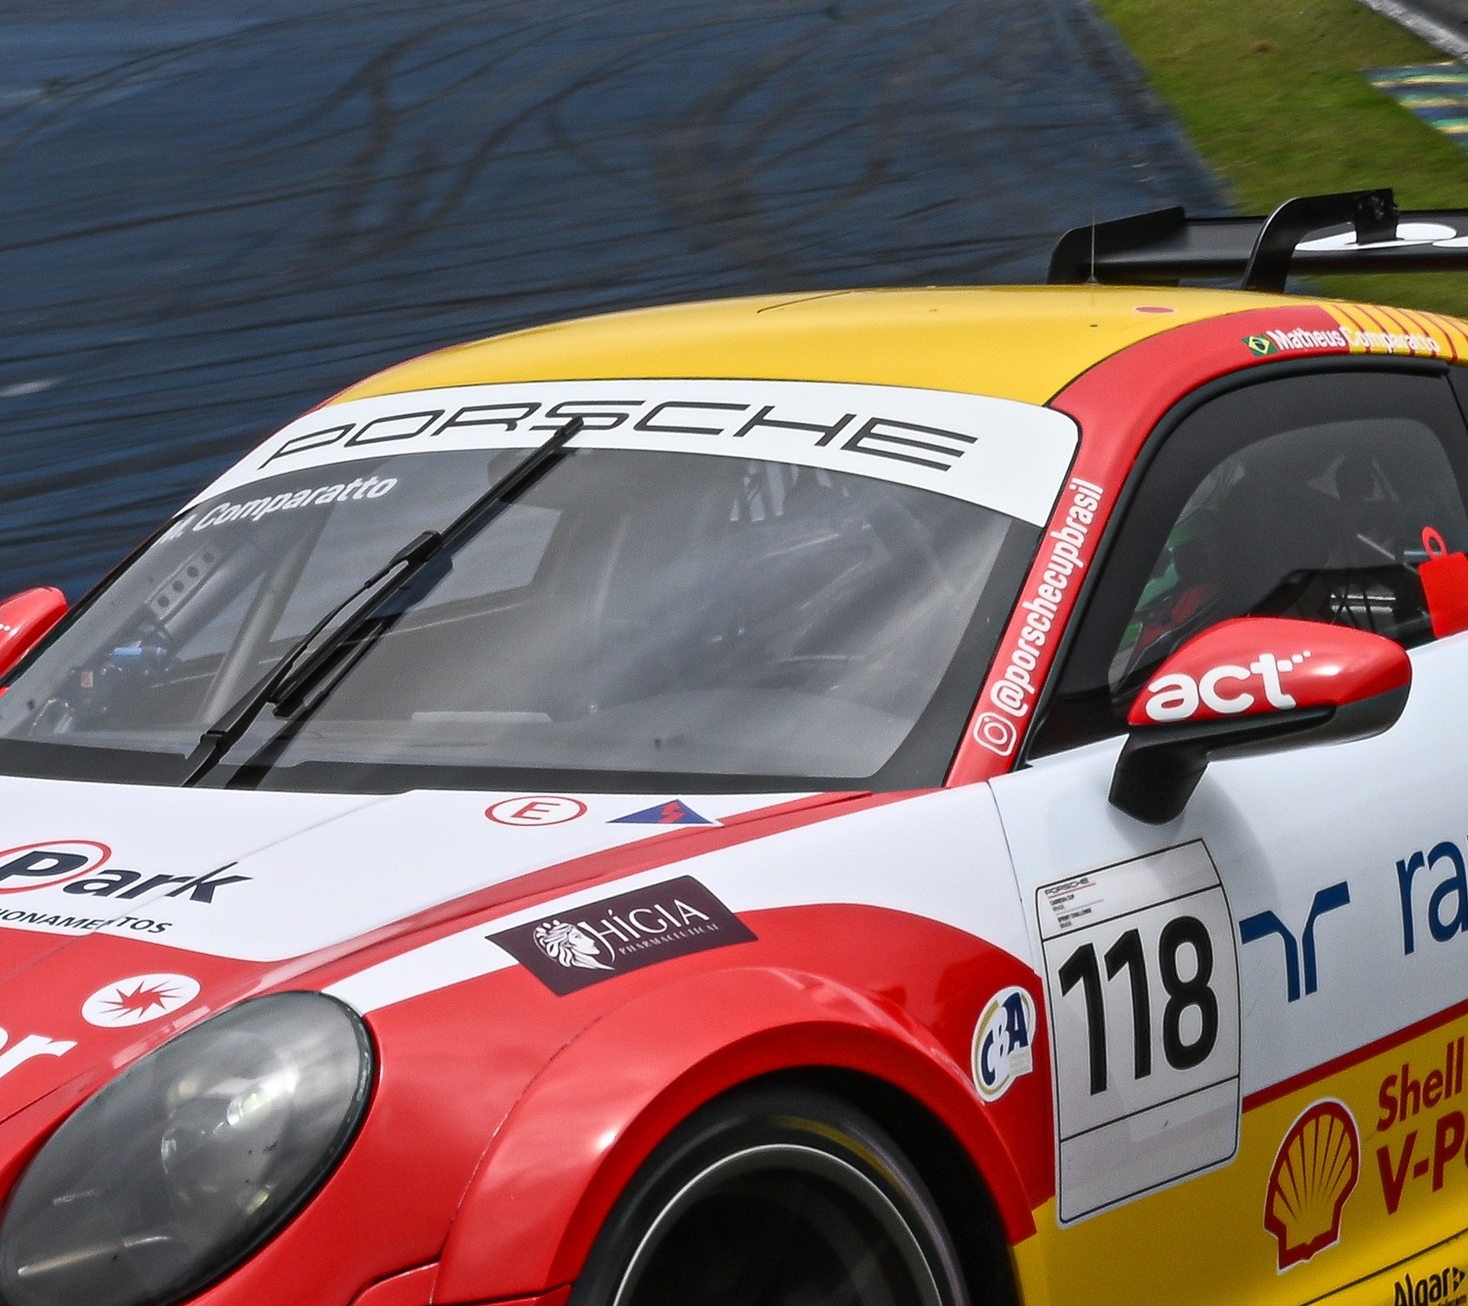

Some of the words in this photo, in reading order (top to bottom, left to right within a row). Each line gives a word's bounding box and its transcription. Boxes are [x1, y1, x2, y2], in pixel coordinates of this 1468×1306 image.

[1266, 328, 1346, 350] Matheus
[258, 400, 977, 471] PORSCHE
[192, 477, 397, 532] Comparatto
[990, 478, 1104, 717] @porschecupbrasil
[1145, 652, 1298, 722] act
[981, 992, 1029, 1086] CBA
[1058, 915, 1219, 1096] 118
[1376, 1036, 1465, 1132] Shell
